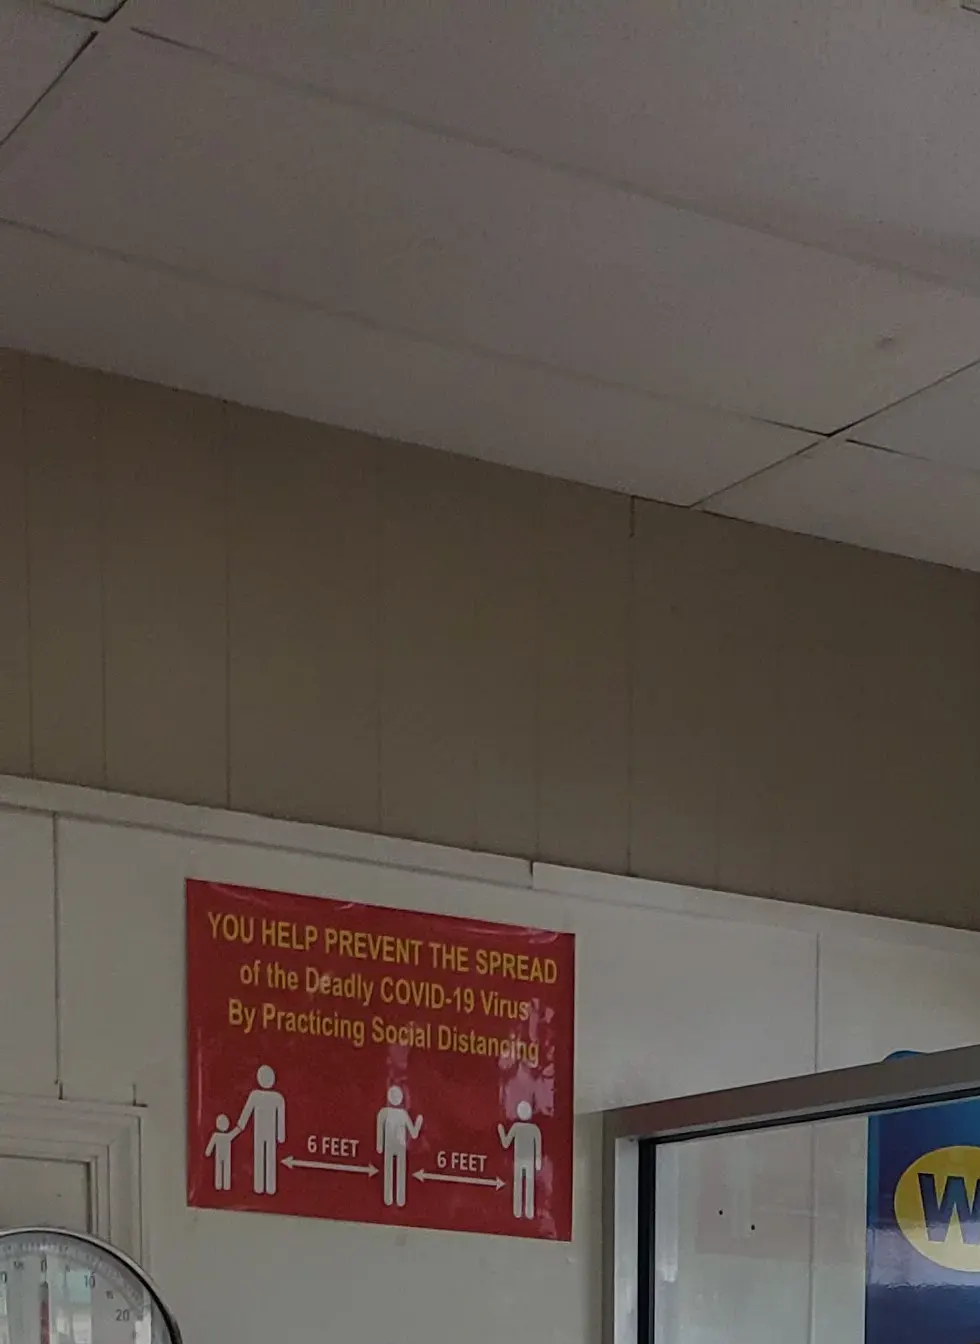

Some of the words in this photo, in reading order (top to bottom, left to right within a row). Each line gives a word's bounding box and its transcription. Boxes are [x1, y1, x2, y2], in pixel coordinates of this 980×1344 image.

[208, 911, 254, 944] YOU
[261, 918, 318, 951] HELP
[324, 927, 424, 966] PREVENT
[428, 942, 470, 973] THE
[475, 949, 558, 984] SPREAD
[239, 960, 261, 986] of
[266, 961, 299, 991] the
[305, 966, 374, 1006] Deadly
[380, 976, 475, 1014] COVID-19
[480, 988, 531, 1021] Virus
[228, 997, 256, 1034] By
[262, 1003, 365, 1047] Practicing
[371, 1016, 432, 1049] Social
[438, 1024, 540, 1069] Distancing
[307, 1135, 318, 1153] 6
[321, 1139, 360, 1159] FEET
[437, 1151, 447, 1169] 6
[451, 1155, 488, 1174] FEET
[115, 1308, 130, 1322] 20
